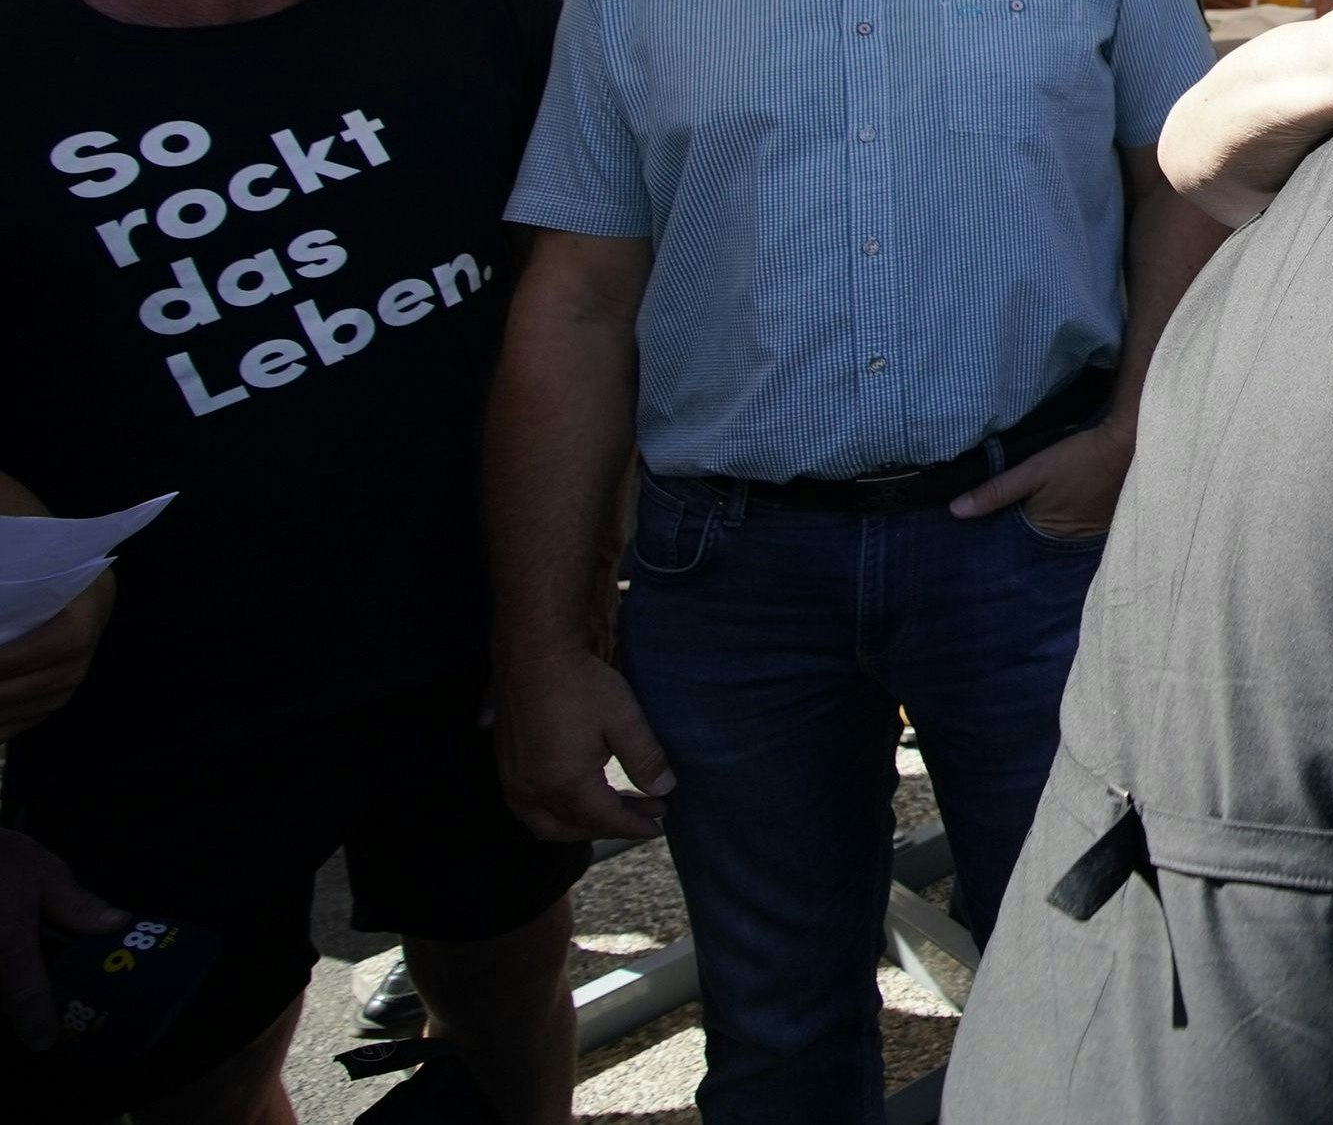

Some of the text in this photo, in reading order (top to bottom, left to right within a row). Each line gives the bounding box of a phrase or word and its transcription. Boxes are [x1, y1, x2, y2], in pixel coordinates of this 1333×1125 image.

[49, 119, 211, 198] So
[95, 108, 391, 268] rockt
[139, 229, 348, 336] das
[165, 251, 492, 417] Leben.
